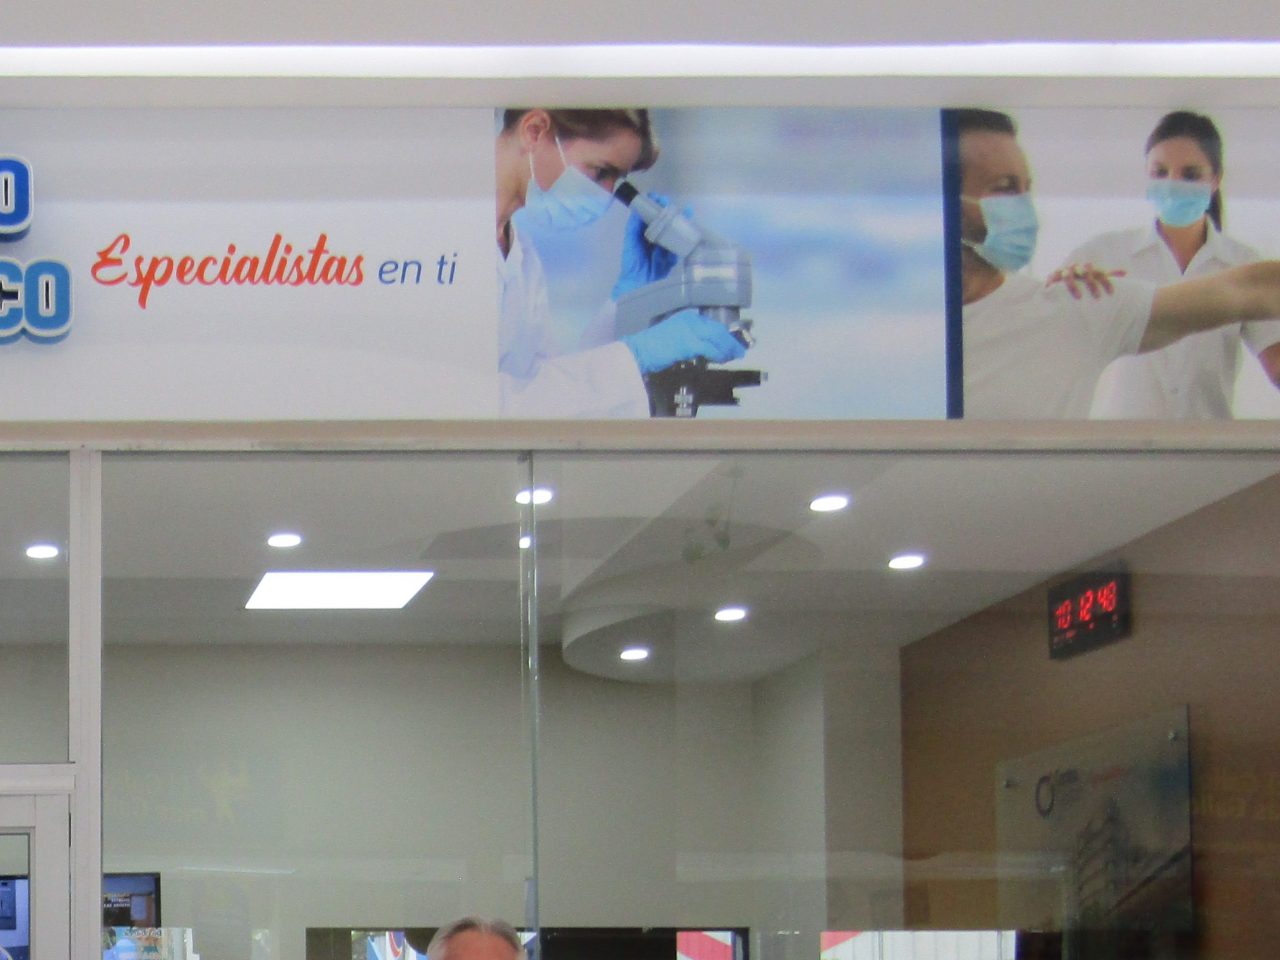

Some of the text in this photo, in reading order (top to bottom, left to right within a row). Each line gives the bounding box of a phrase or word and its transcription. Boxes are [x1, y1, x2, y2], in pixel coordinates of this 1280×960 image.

[90, 232, 460, 311] Especialistas en ti
